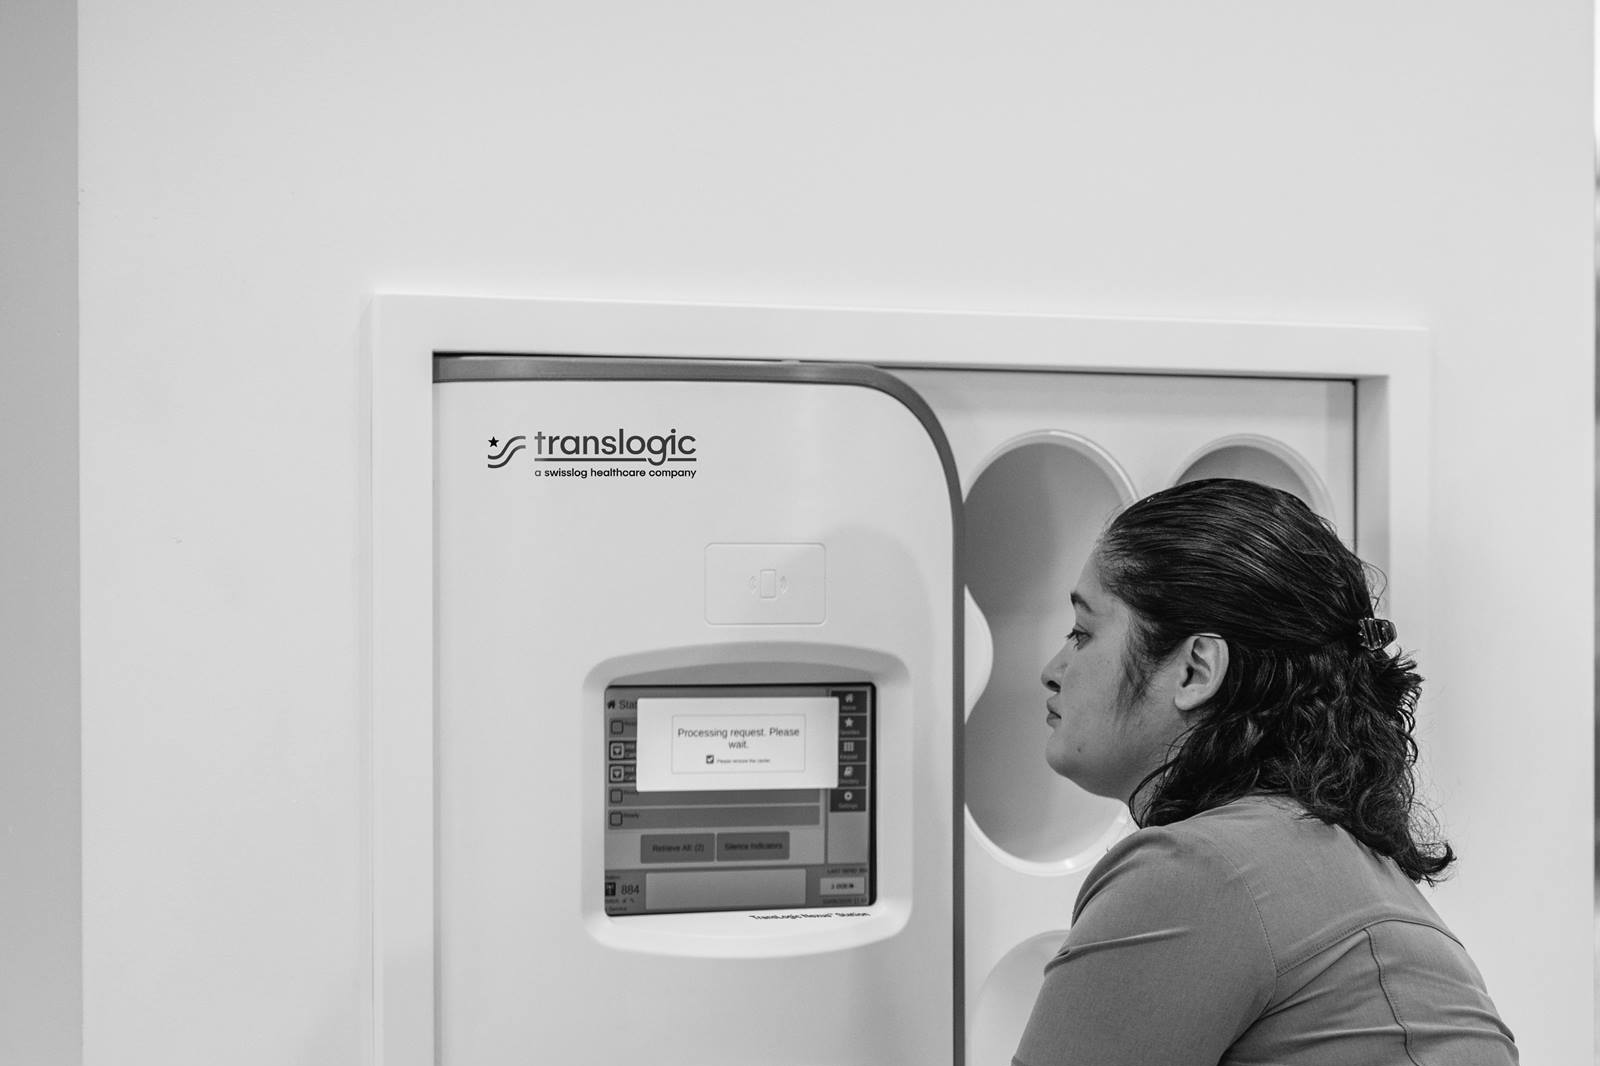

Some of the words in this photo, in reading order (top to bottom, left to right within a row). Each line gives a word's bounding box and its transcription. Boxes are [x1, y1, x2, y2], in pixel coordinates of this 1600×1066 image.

[534, 428, 697, 466] translogic
[534, 469, 542, 477] a
[544, 468, 588, 479] swisslog
[590, 468, 646, 477] healthcare
[649, 469, 697, 479] company
[677, 728, 728, 739] Processing
[730, 728, 766, 739] request.
[769, 727, 800, 737] Please
[728, 741, 749, 749] wait.
[621, 884, 640, 896] 884
